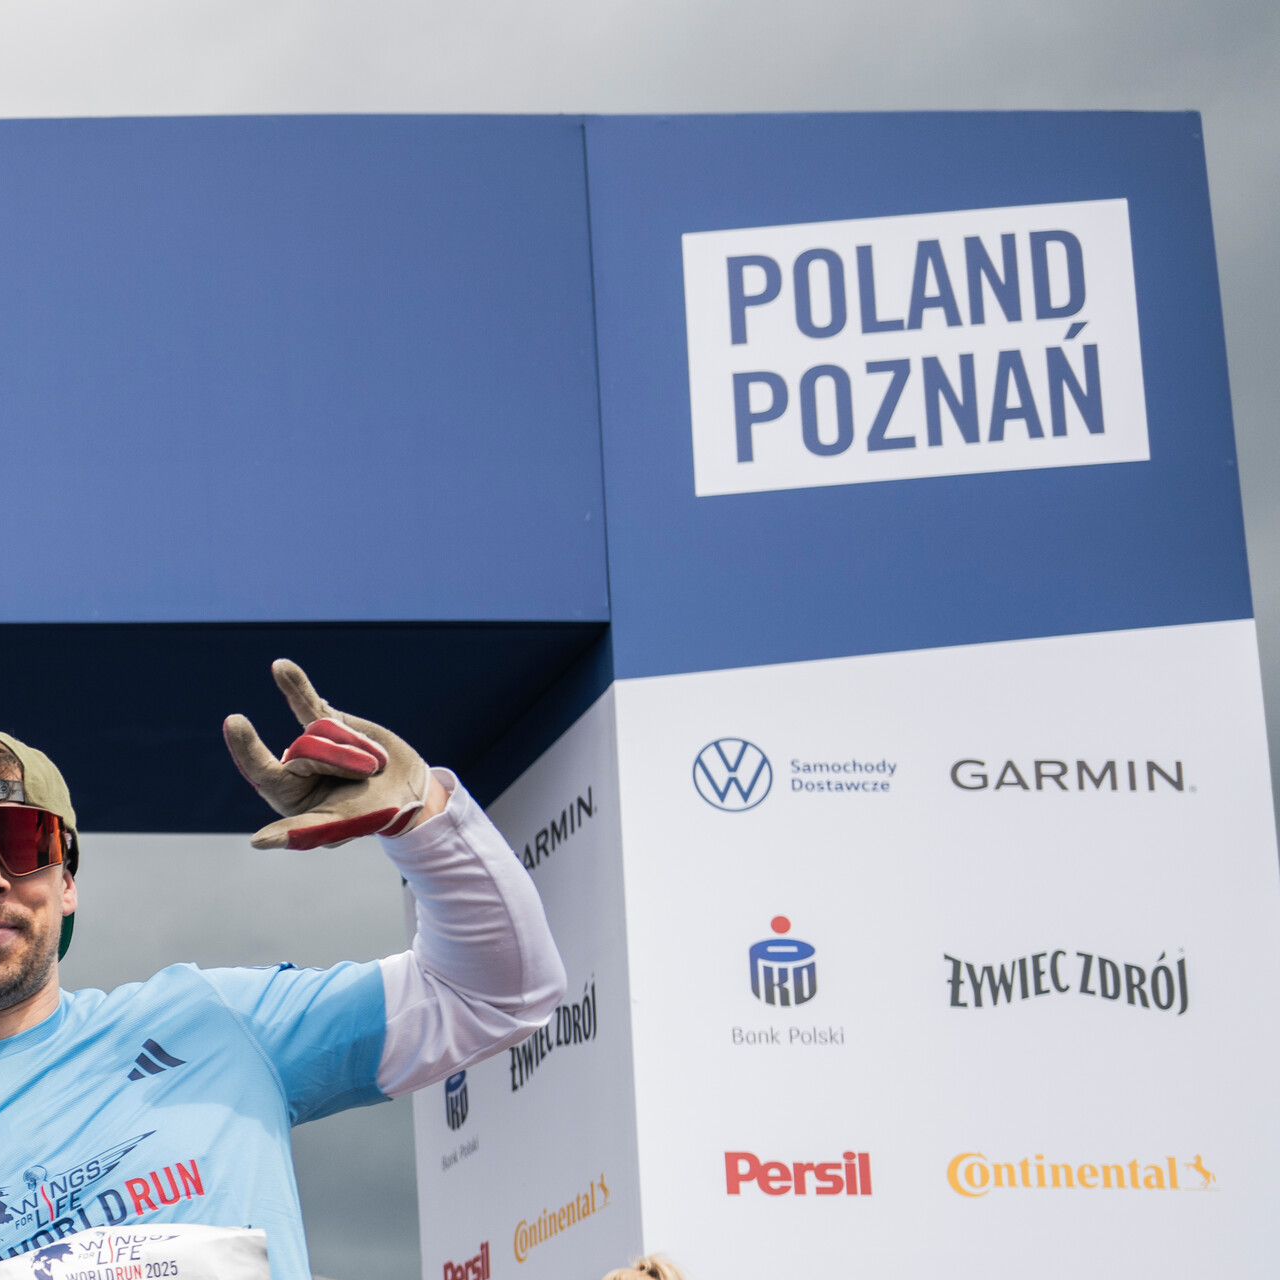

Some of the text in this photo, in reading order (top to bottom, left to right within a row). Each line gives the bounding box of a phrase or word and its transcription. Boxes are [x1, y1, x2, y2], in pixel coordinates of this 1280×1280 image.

[726, 230, 1087, 346] POLAND
[731, 321, 1106, 464] POZNAŃ
[790, 759, 897, 777] Samochody
[790, 777, 890, 793] Dostawcze
[950, 759, 1185, 792] GARMIN
[520, 785, 594, 871] ARMIN
[943, 949, 1190, 1016] ŻYWIEC ZDRÓJ
[554, 979, 598, 1048] ZDRÓJ
[732, 1026, 845, 1045] Bank Polski
[8, 1159, 101, 1217] WINGS
[124, 1159, 205, 1217] RUN
[724, 1150, 873, 1196] Persil
[946, 1152, 1179, 1197] Continental
[15, 1212, 34, 1230] FOR
[513, 1180, 597, 1265] Continental
[145, 1260, 179, 1279] 2025
